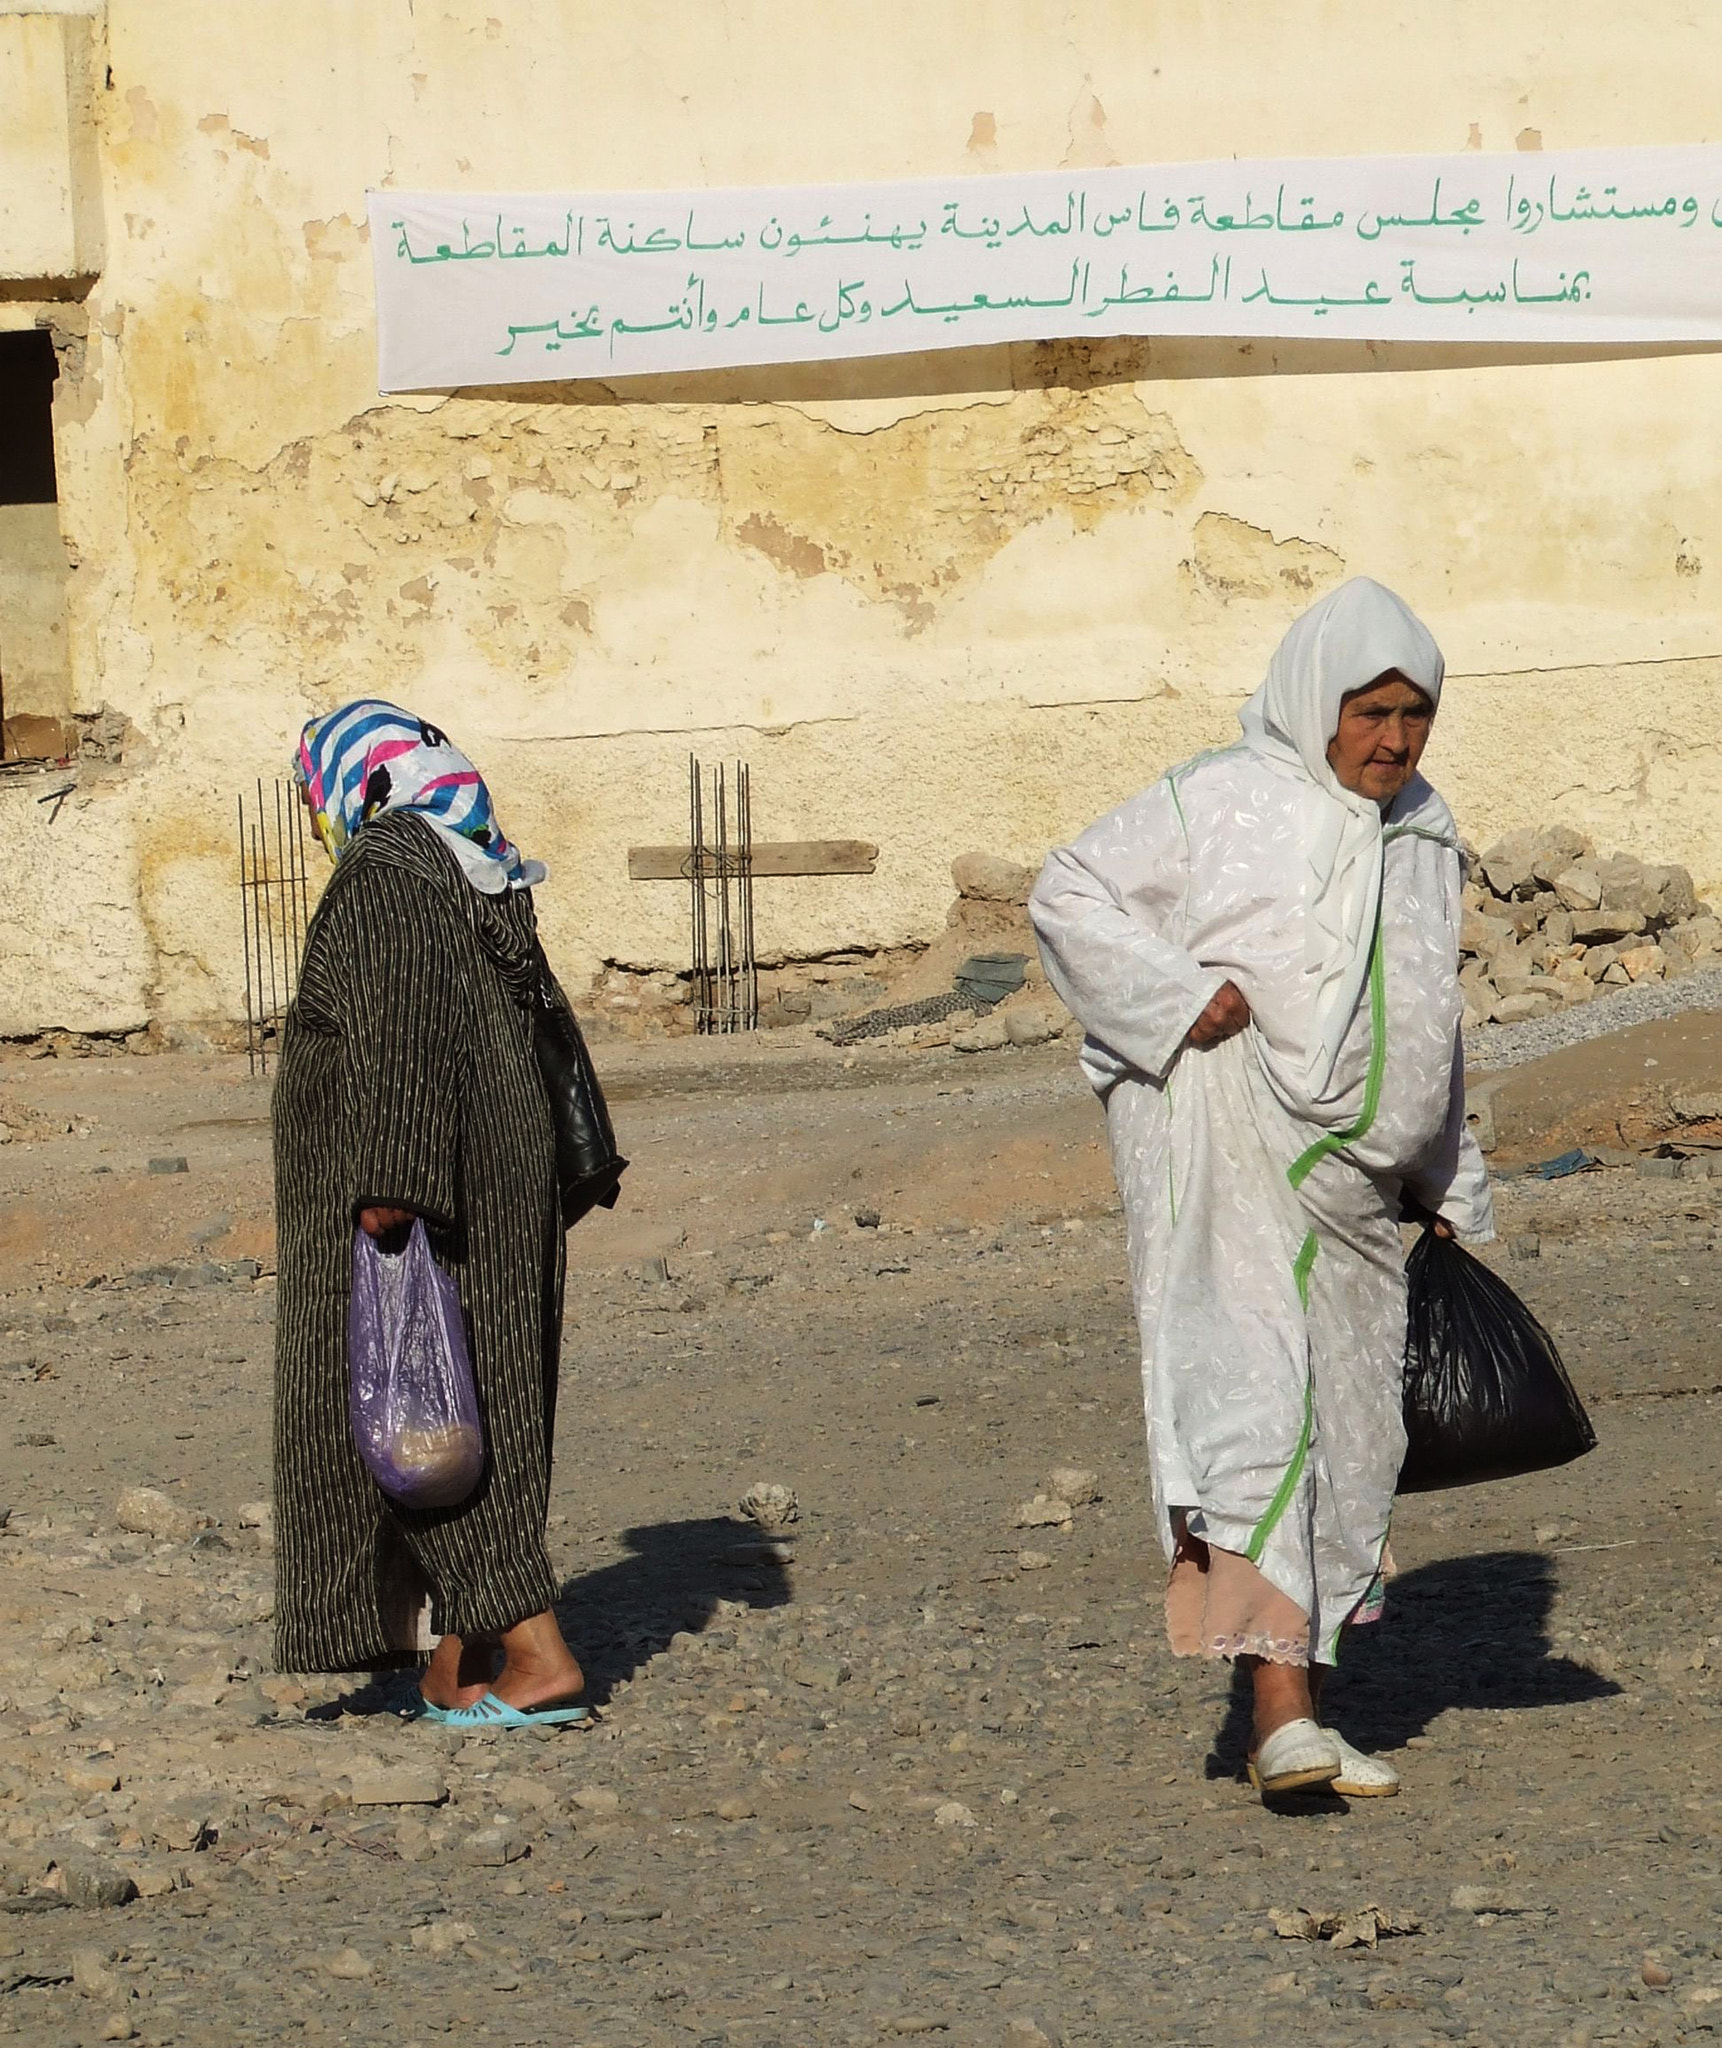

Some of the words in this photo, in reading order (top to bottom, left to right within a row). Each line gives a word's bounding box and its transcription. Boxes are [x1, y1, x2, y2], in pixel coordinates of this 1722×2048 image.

[940, 191, 1086, 248] المدينة
[1094, 191, 1181, 237] فاس
[1187, 184, 1344, 233] مقاطعة
[1357, 176, 1485, 241] مجلس
[1507, 173, 1699, 232] ومستشاروا
[391, 209, 583, 265] المقاطعة
[597, 209, 745, 256] ساكنة
[759, 214, 927, 257] يهنئون
[725, 281, 815, 329] عام
[818, 278, 872, 334] وكل
[880, 254, 1090, 325] السعيد
[1083, 252, 1231, 318] الفطر
[1241, 267, 1393, 317] عيد
[1400, 256, 1592, 313] بمناسبة
[495, 304, 605, 356] بخير
[610, 272, 718, 360] وأنتم
